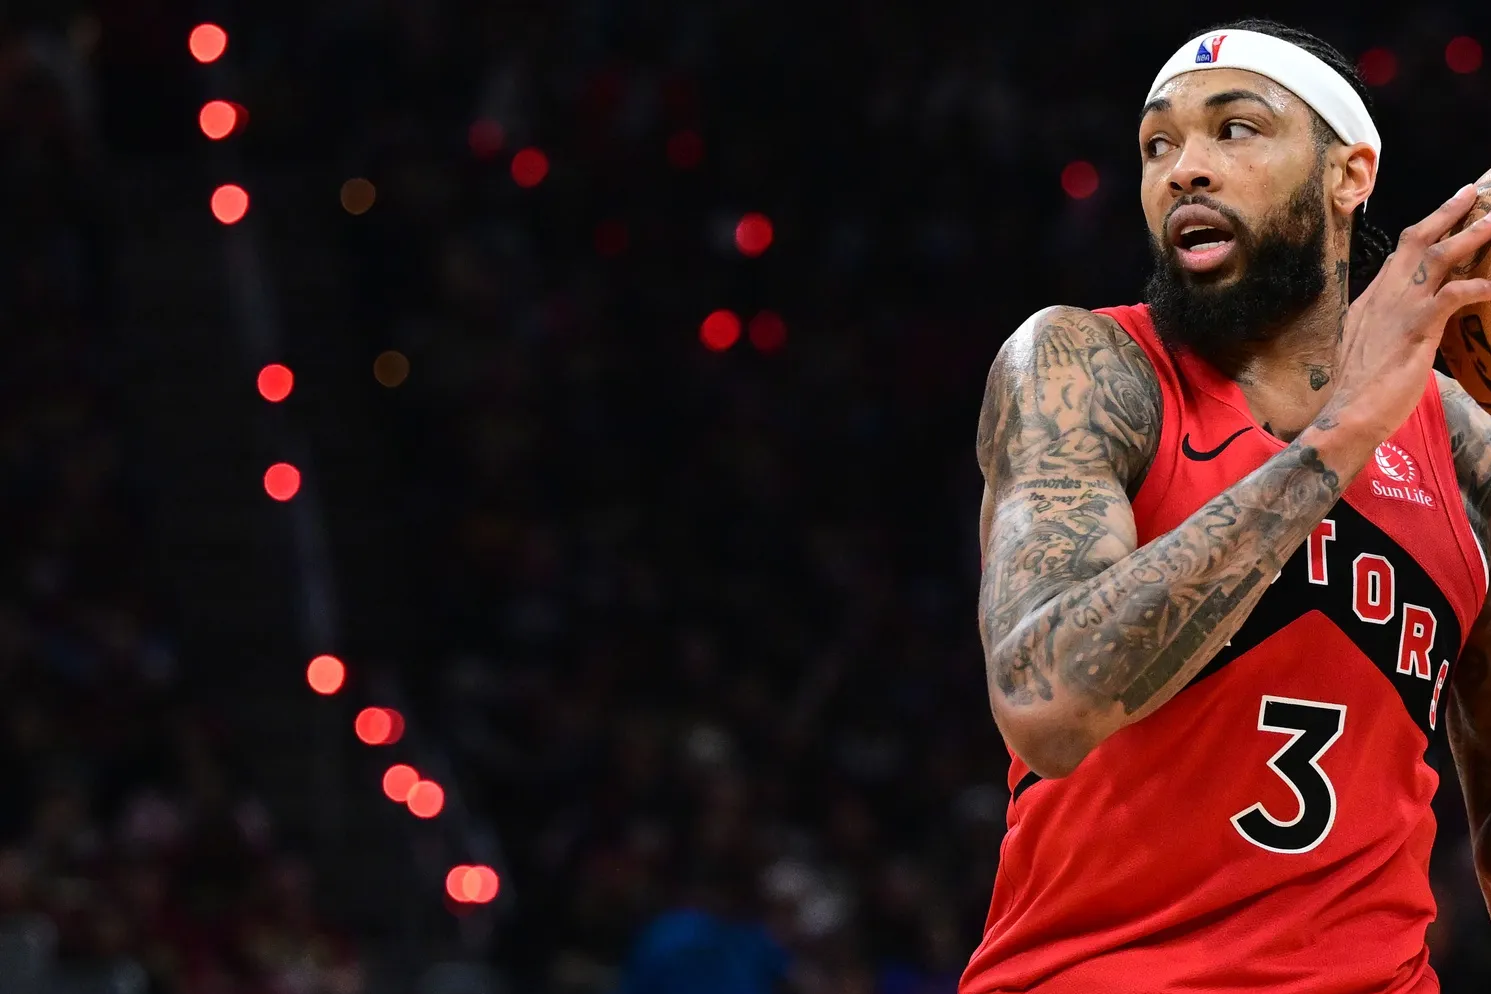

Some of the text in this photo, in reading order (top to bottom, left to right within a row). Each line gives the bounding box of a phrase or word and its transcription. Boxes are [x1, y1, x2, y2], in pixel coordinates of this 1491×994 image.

[1371, 479, 1434, 507] Sun Life
[1229, 694, 1348, 854] 3
